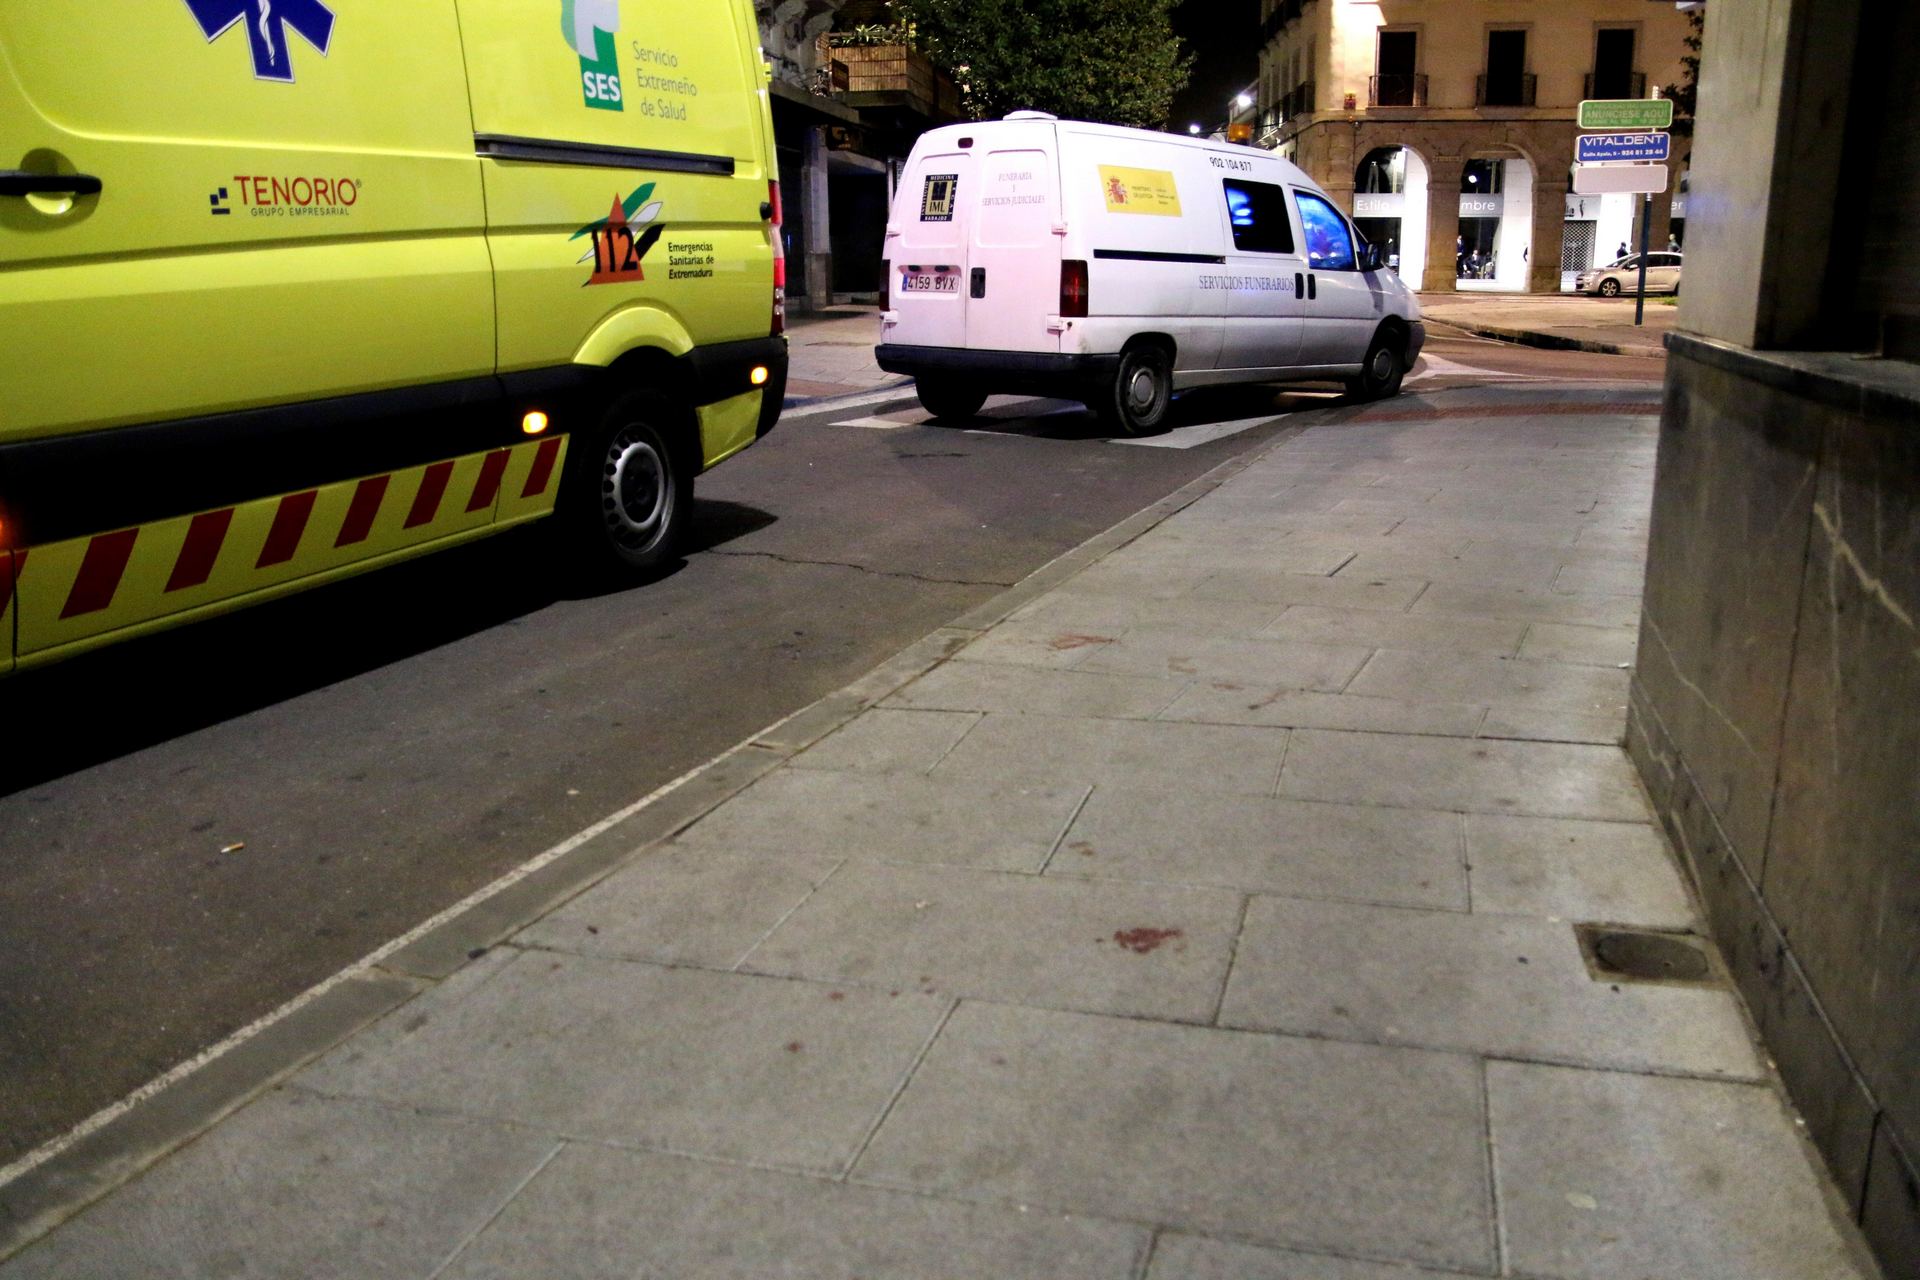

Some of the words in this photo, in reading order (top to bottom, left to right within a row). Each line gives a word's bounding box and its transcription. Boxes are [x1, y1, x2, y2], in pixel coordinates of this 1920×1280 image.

[632, 40, 678, 68] Servicio
[583, 71, 621, 101] SES
[636, 67, 697, 96] Extremeño
[641, 96, 655, 117] de
[658, 98, 687, 121] Salud
[1583, 135, 1665, 146] VITALDENT
[1209, 156, 1224, 168] 902
[1225, 159, 1239, 170] 104
[233, 175, 358, 206] TENORIO
[251, 207, 284, 217] GRUPO
[289, 207, 350, 217] EMPRESARIAL
[929, 201, 946, 213] IML
[591, 226, 638, 274] 112
[668, 242, 713, 255] Emergencias
[669, 256, 703, 266] Sanitarias
[705, 256, 714, 265] de
[668, 269, 713, 280] Extremadura
[908, 276, 931, 290] 4159
[935, 276, 956, 290] BVX
[1199, 275, 1243, 290] SERVICIOS
[1244, 276, 1295, 291] FUNERARIOS
